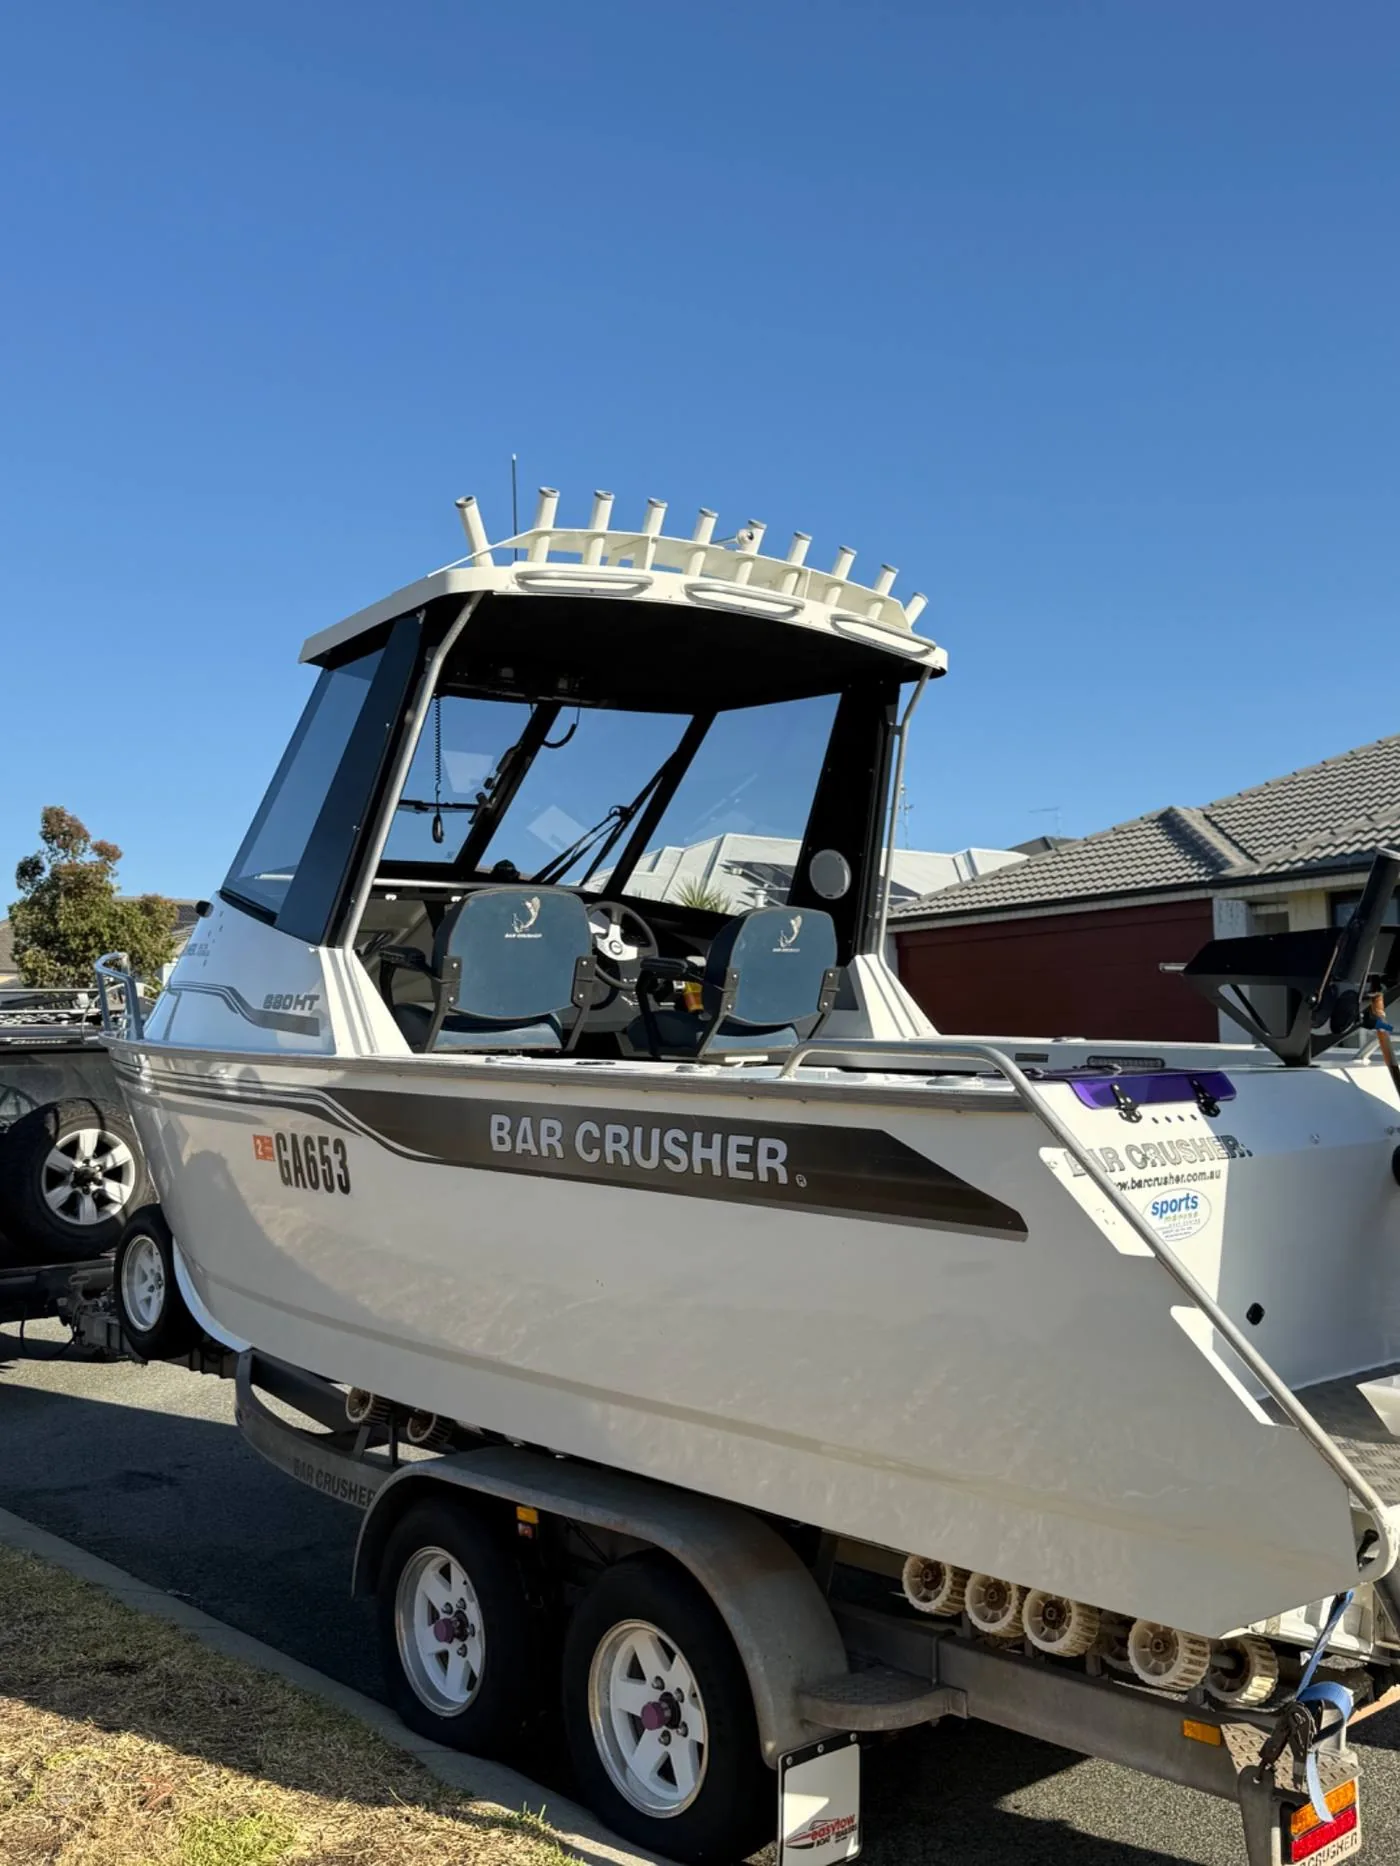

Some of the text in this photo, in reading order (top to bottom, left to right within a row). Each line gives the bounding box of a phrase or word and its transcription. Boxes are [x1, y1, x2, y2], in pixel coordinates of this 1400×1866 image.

[275, 1132, 350, 1195] GA653
[490, 1113, 564, 1159] BAR
[574, 1120, 788, 1185] CRUSHER
[1125, 1135, 1246, 1170] CRUSHER
[1151, 1193, 1199, 1219] sports
